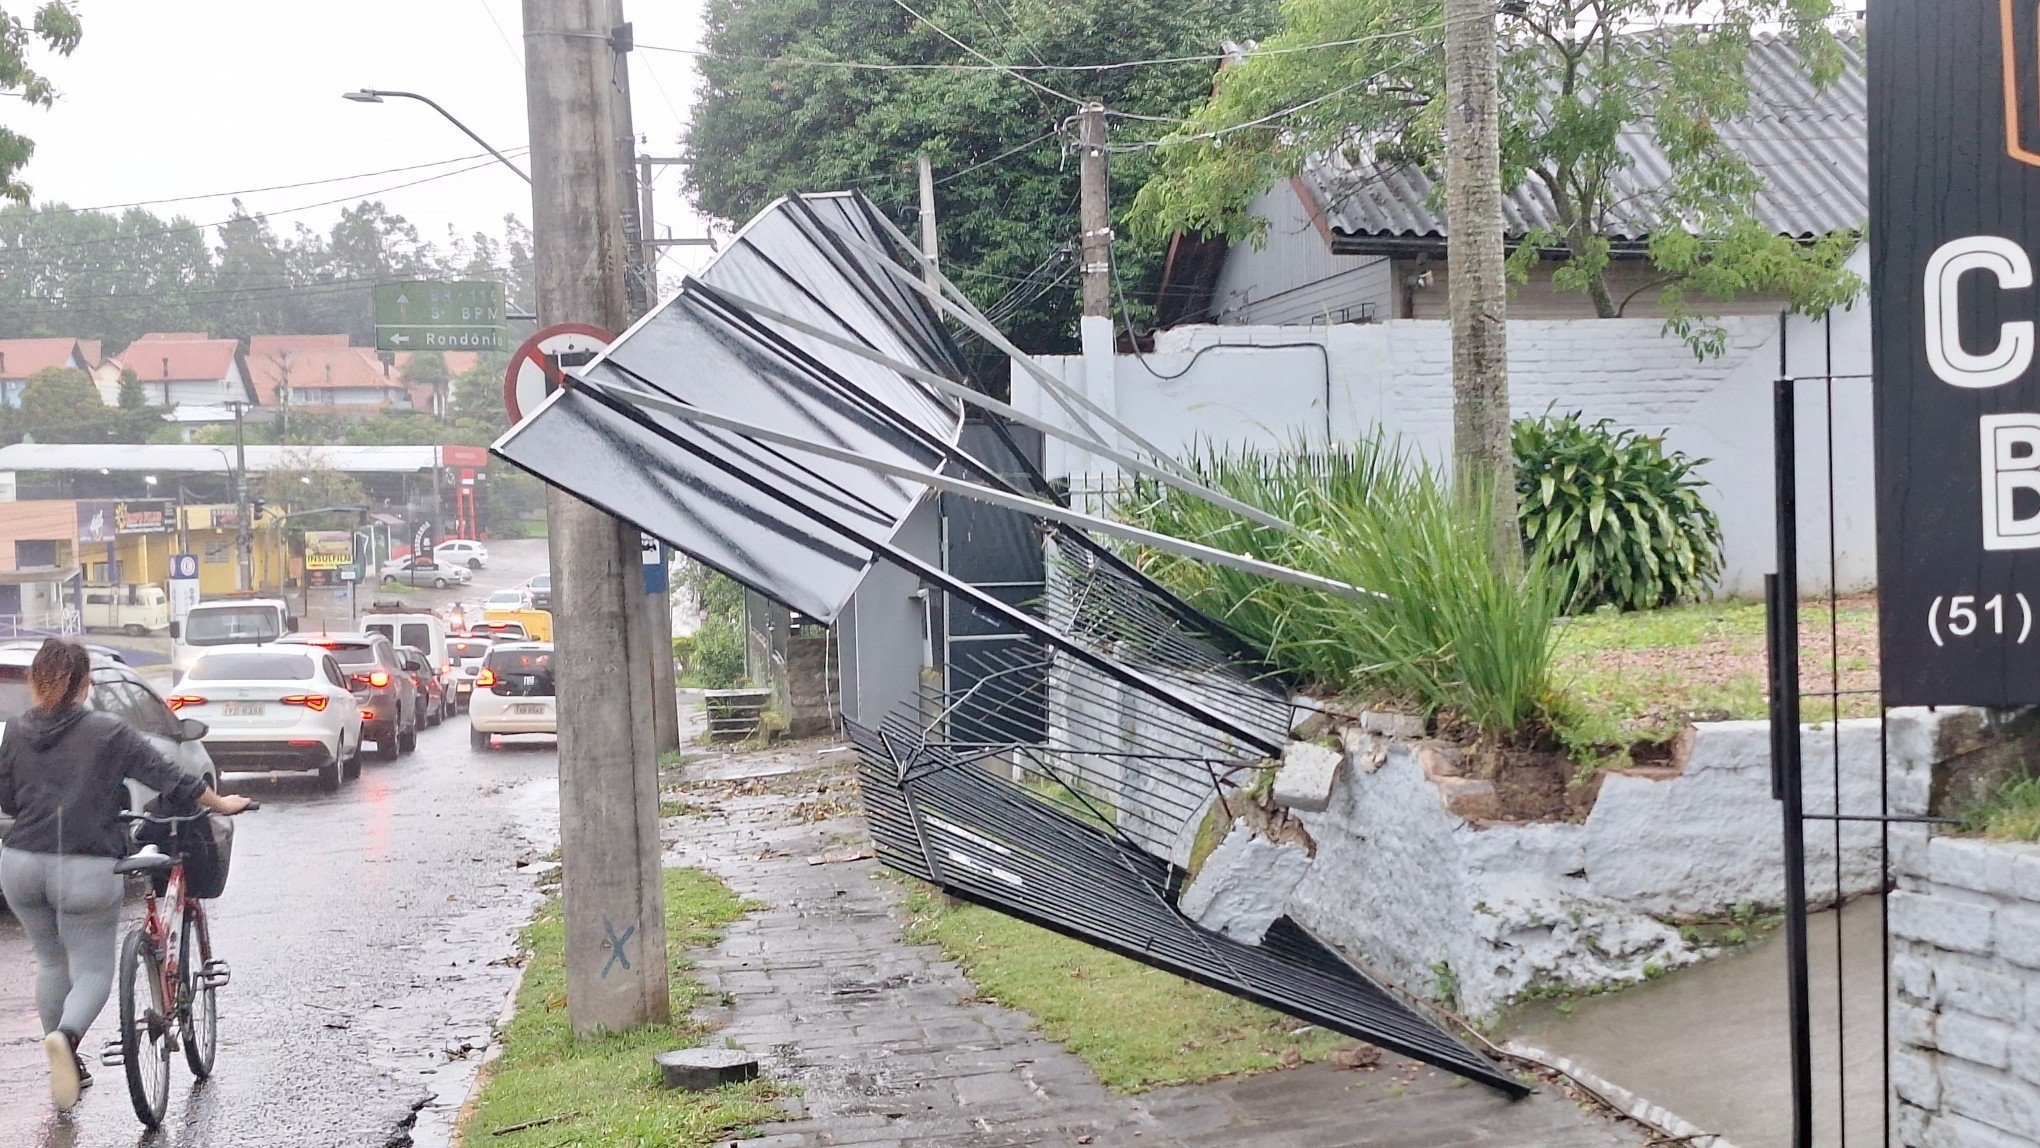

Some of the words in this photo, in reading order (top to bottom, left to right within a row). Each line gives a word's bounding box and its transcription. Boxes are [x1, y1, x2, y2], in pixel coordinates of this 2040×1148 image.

[1923, 235, 2035, 389] C
[426, 332, 503, 347] Rondônia
[308, 554, 351, 563] INSULFILM
[1927, 592, 2033, 648] (51)
